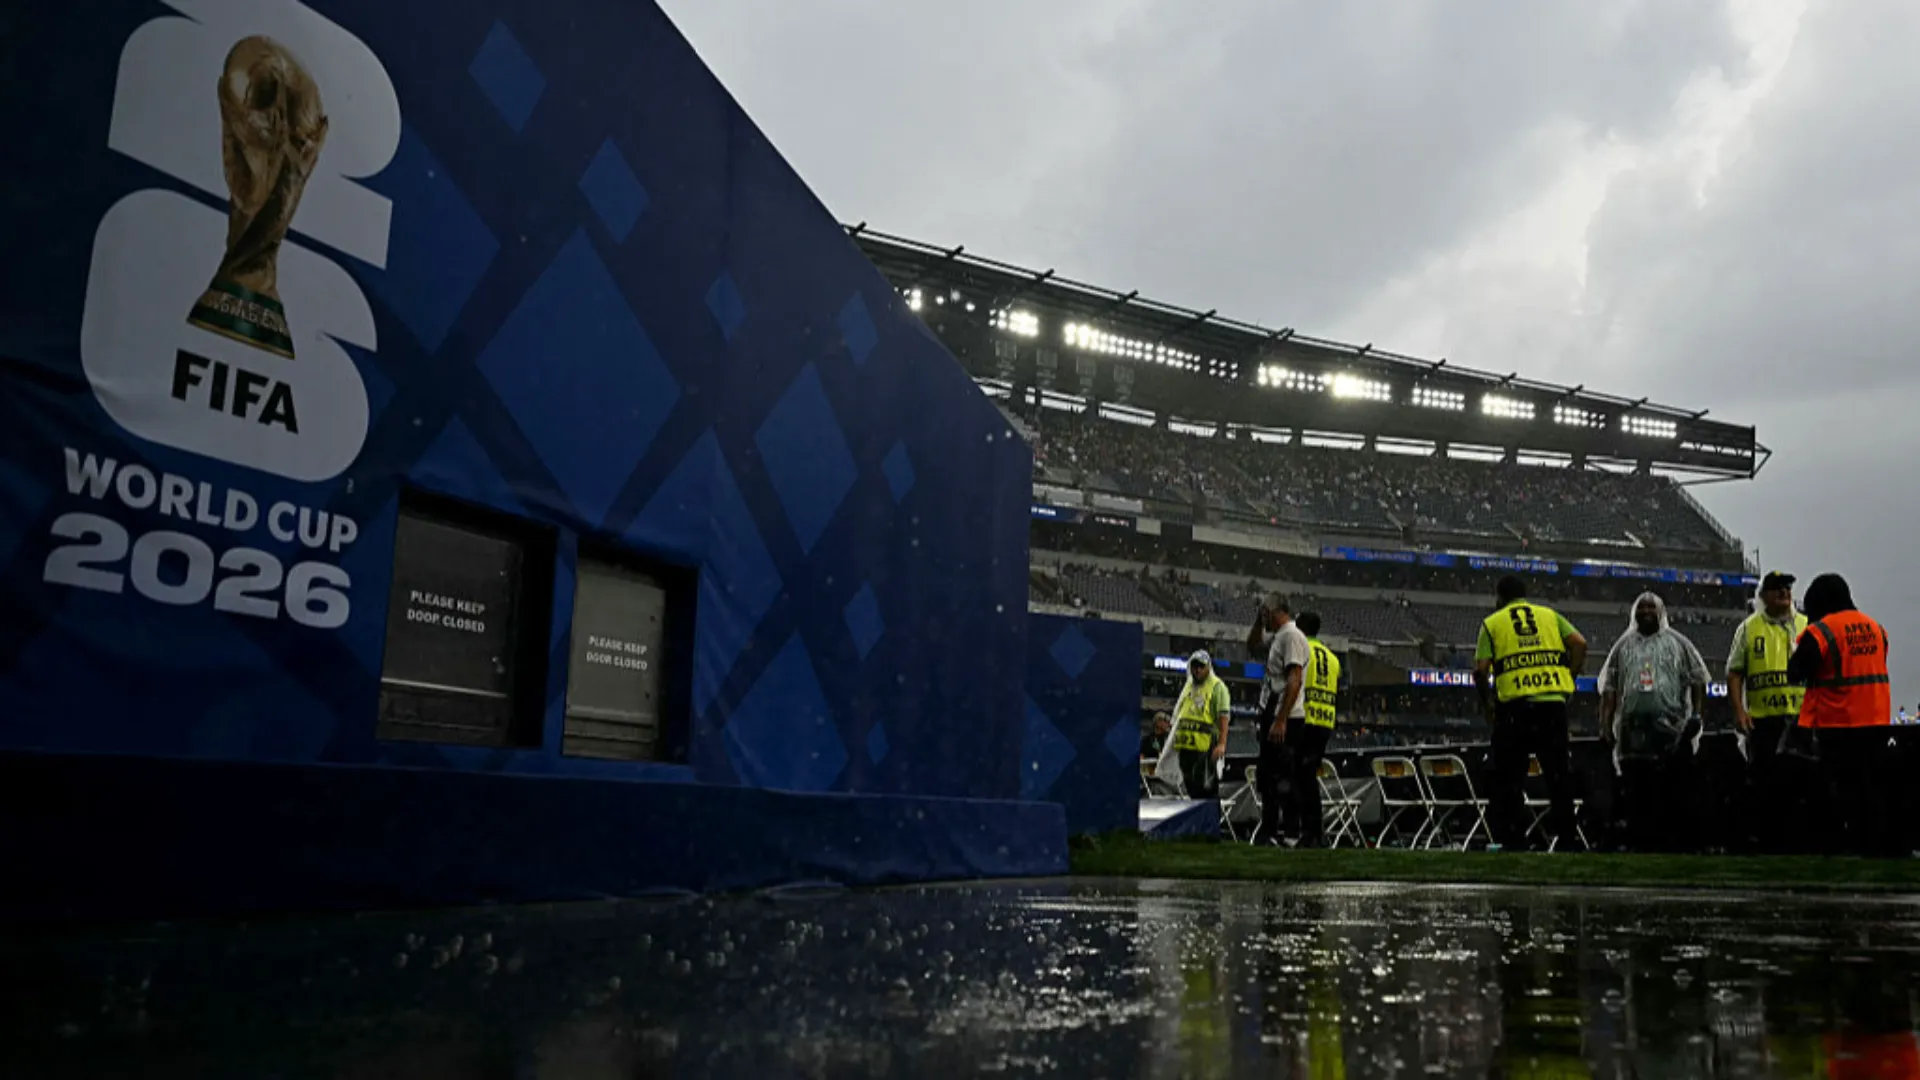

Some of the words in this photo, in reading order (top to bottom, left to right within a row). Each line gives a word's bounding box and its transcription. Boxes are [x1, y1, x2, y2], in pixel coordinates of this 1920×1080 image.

[171, 348, 299, 434] FIFA
[63, 446, 260, 532] WORLD
[267, 500, 358, 552] CUP
[42, 511, 352, 629] 2026
[410, 590, 454, 610] PLEASE
[456, 598, 485, 614] KEEP
[441, 614, 485, 633] CLOSED
[1845, 622, 1871, 634] APEX
[588, 635, 623, 651] PLEASE
[623, 639, 647, 655] KEEP
[1850, 643, 1878, 656] GROUP
[586, 651, 612, 666] DOOR
[613, 655, 648, 671] CLOSED
[1503, 652, 1561, 672] SECURITY
[1513, 672, 1561, 690] 14021
